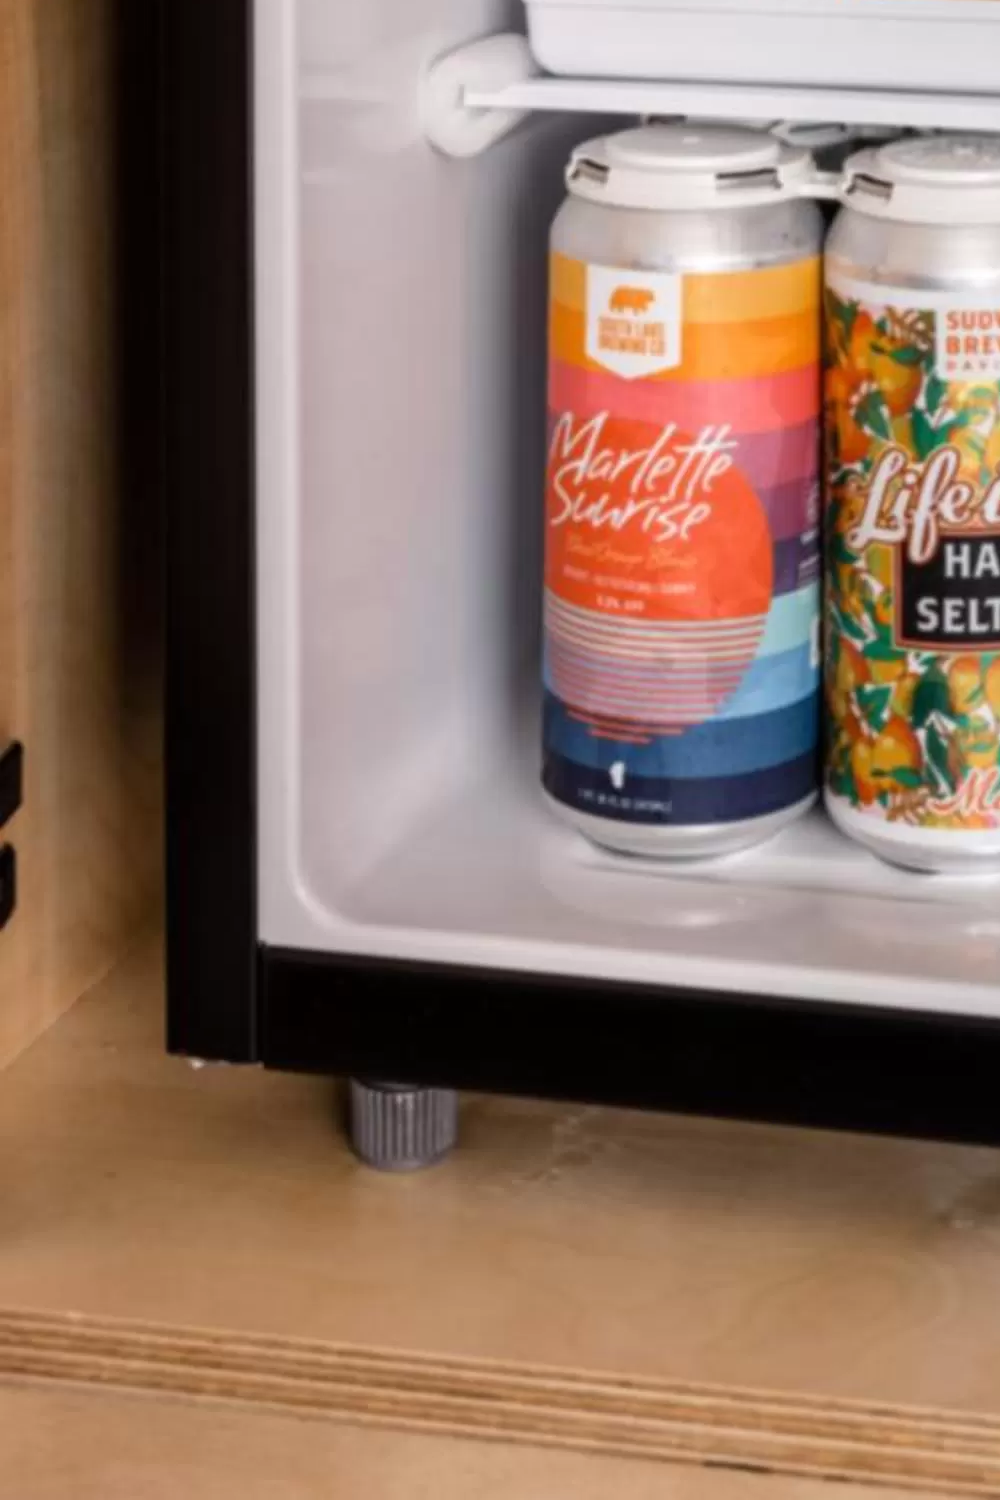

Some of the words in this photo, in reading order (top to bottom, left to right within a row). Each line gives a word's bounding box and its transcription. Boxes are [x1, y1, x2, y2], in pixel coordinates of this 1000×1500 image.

[551, 410, 740, 501] Marlette
[551, 460, 712, 542] Sunrise
[849, 449, 973, 563] Life
